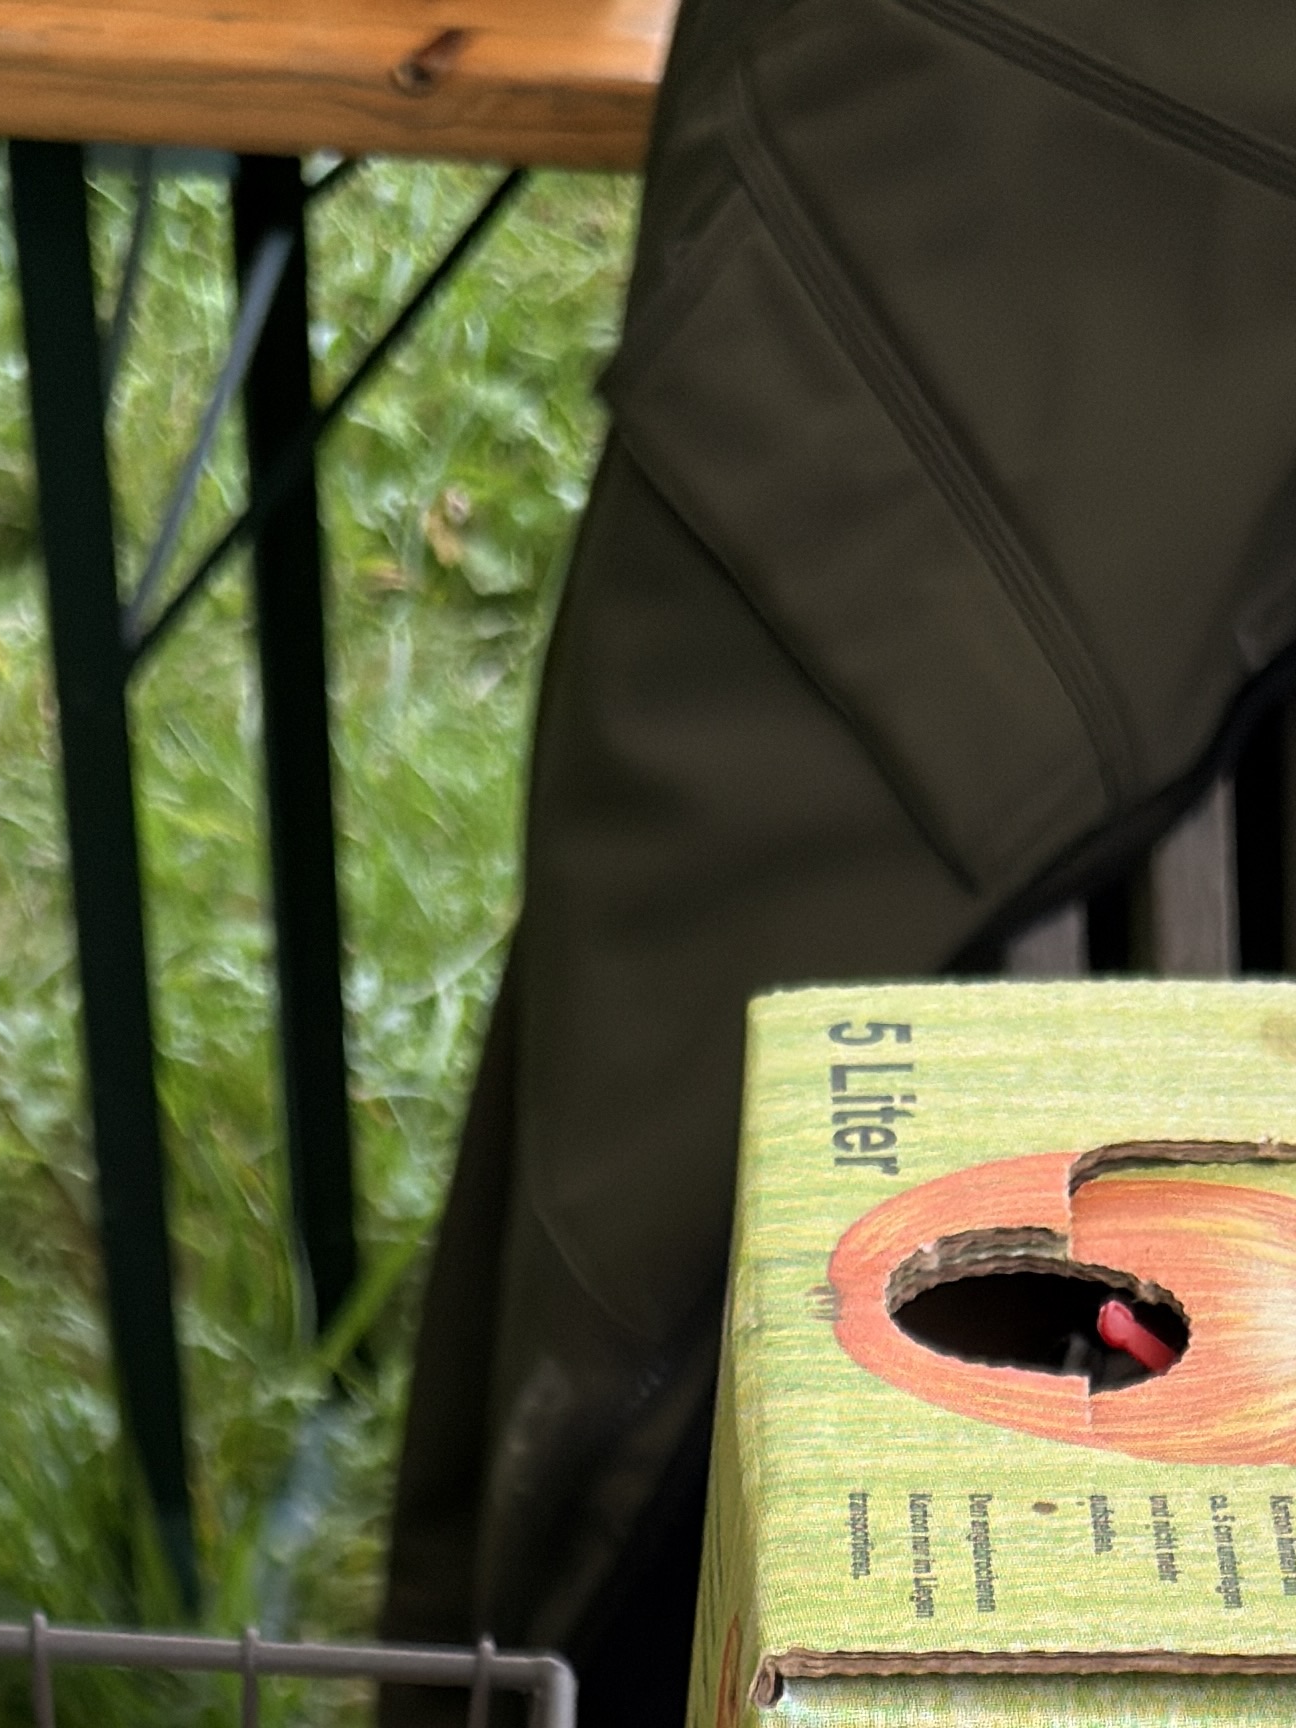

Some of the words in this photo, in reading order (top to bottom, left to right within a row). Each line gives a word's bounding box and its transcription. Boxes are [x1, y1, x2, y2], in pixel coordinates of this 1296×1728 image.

[828, 1021, 912, 1046] 5
[830, 1063, 917, 1176] Liter
[909, 1493, 932, 1533] Karton
[969, 1493, 993, 1517] Den
[1150, 1495, 1174, 1517] und
[1210, 1495, 1228, 1512] ca.
[1269, 1495, 1293, 1534] Karton
[847, 1492, 874, 1579] transportieren.
[911, 1536, 930, 1556] nur
[1154, 1520, 1178, 1549] nicht
[1214, 1525, 1232, 1542] cm
[913, 1558, 935, 1574] im
[967, 1520, 998, 1612] angebrochenen
[1156, 1552, 1181, 1582] mehr
[1215, 1545, 1242, 1608] unterlegen
[910, 1577, 937, 1618] Liegen
